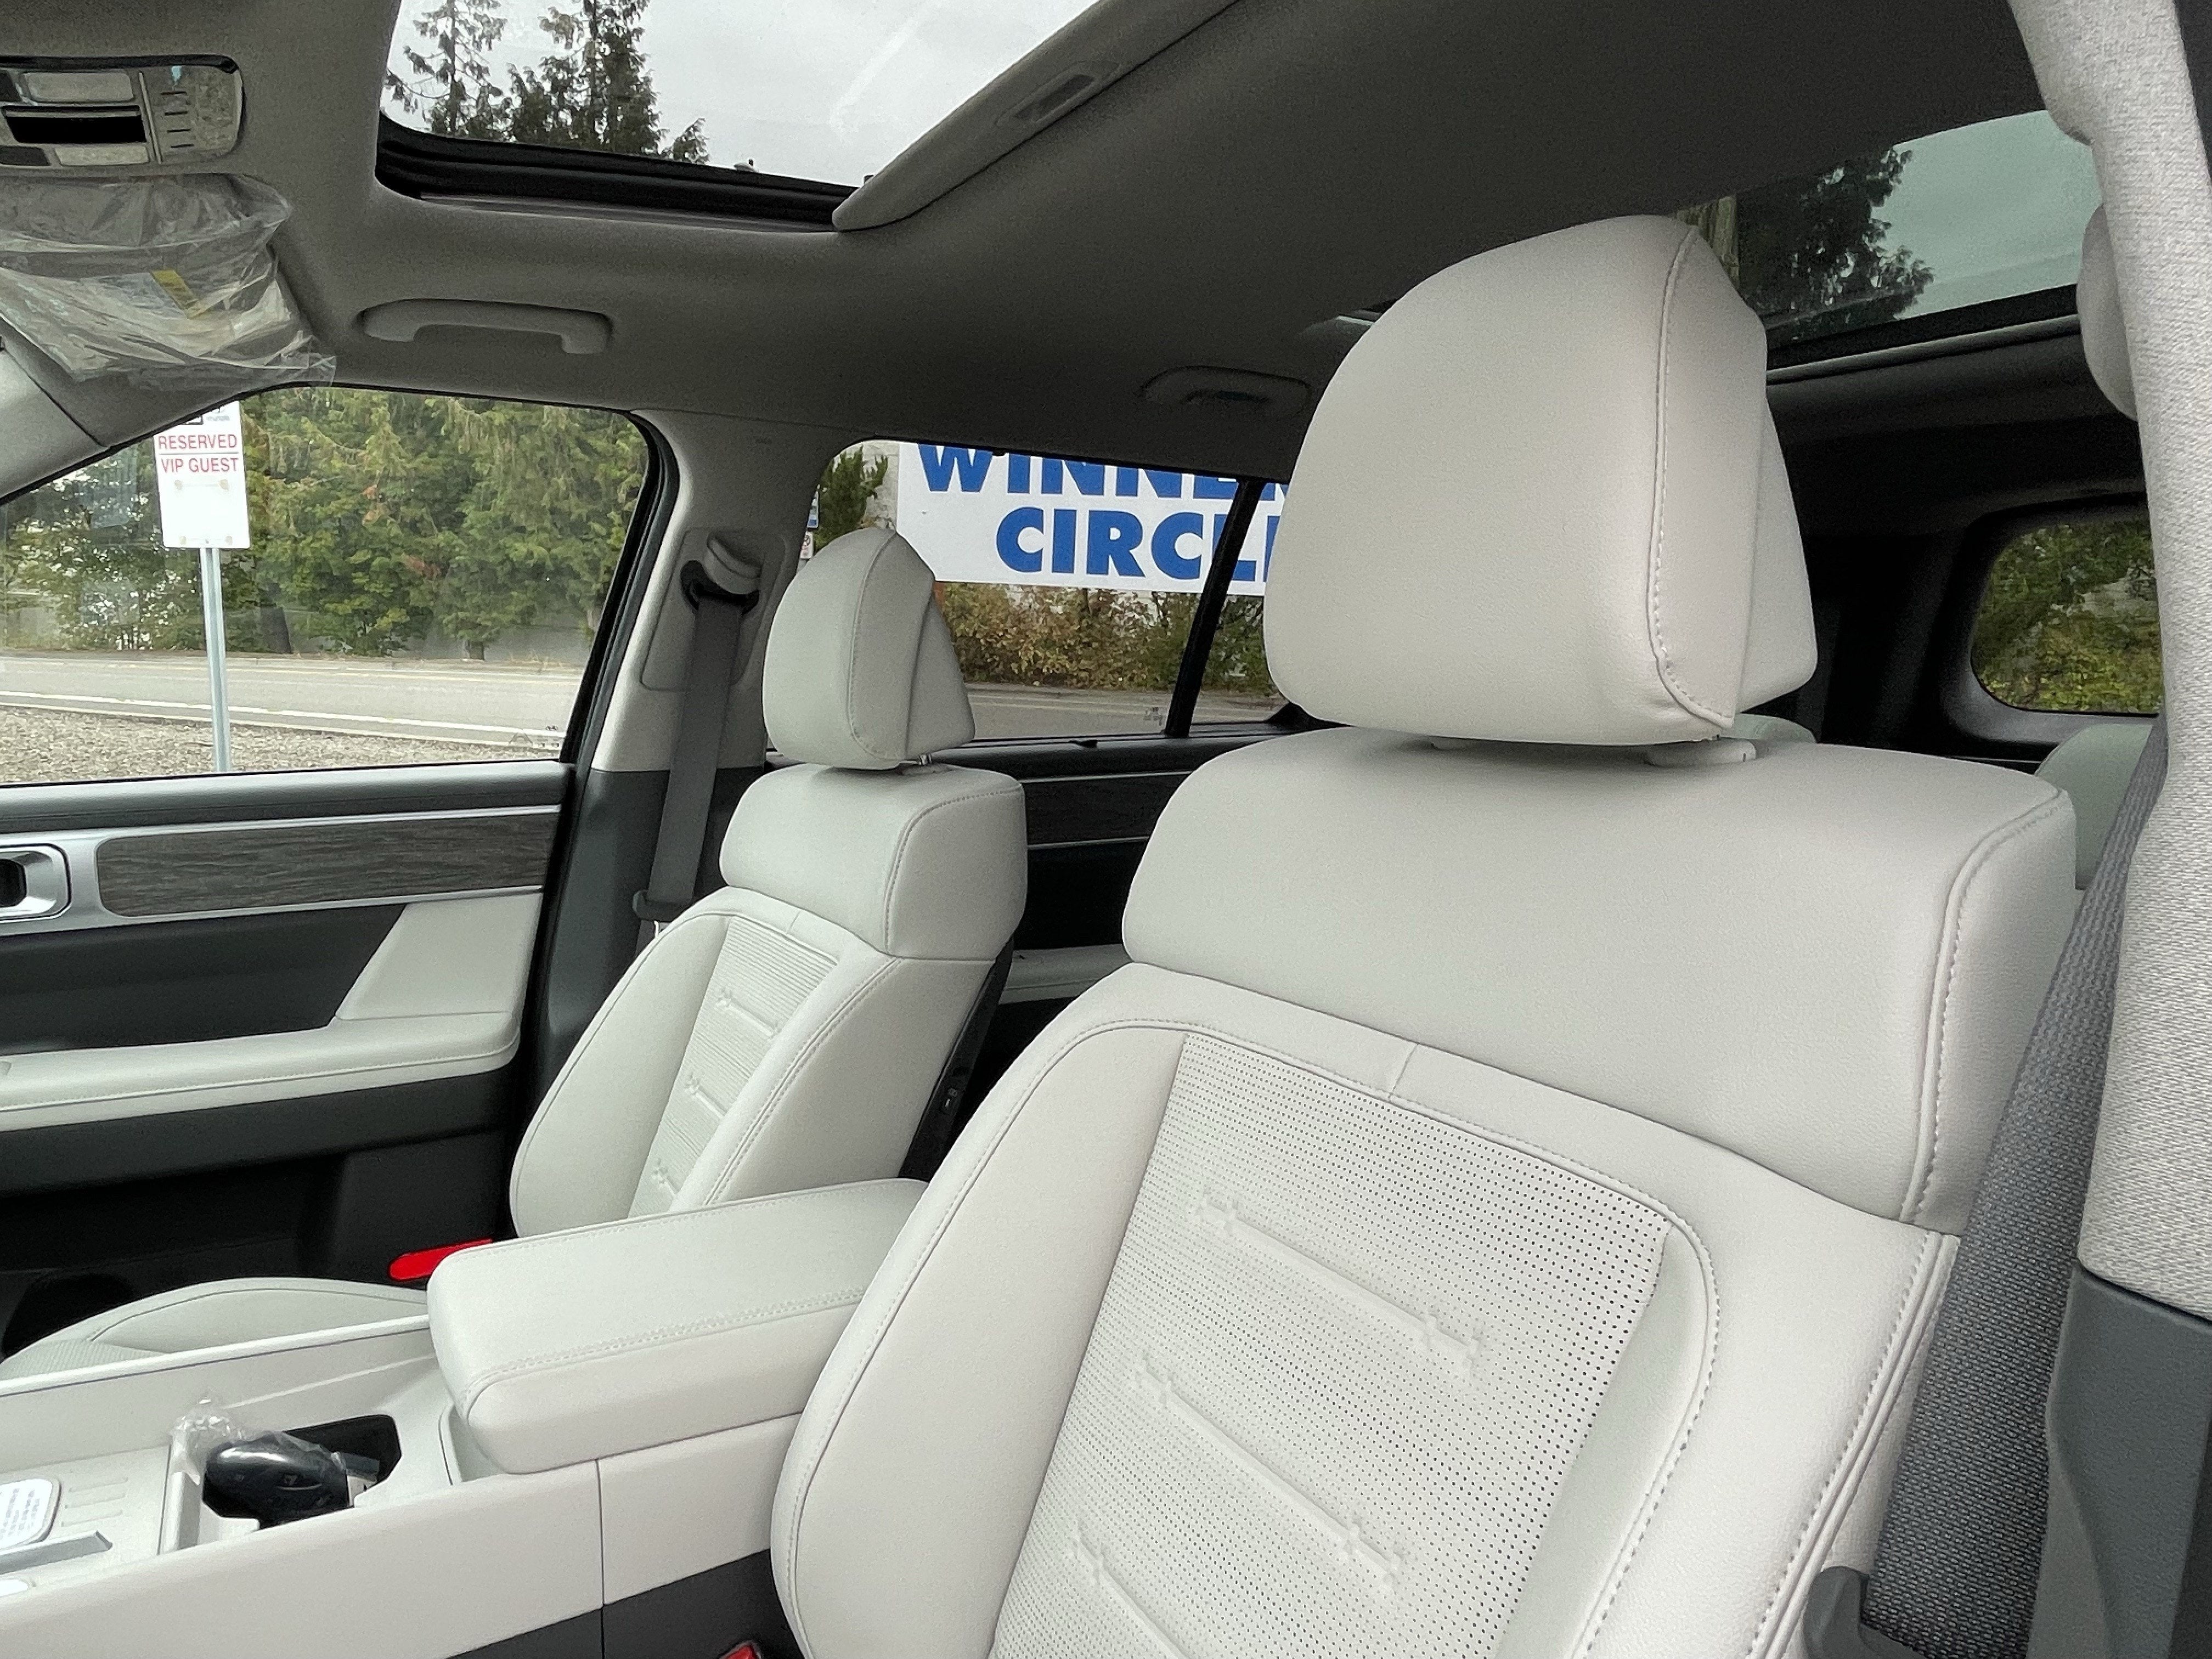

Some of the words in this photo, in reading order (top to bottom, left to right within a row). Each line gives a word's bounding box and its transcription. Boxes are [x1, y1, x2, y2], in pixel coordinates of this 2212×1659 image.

[159, 434, 237, 449] RESERVED
[161, 458, 184, 473] VIP
[189, 458, 239, 473] GUEST
[918, 444, 1289, 501] WIN
[996, 506, 1280, 583] CIRC
